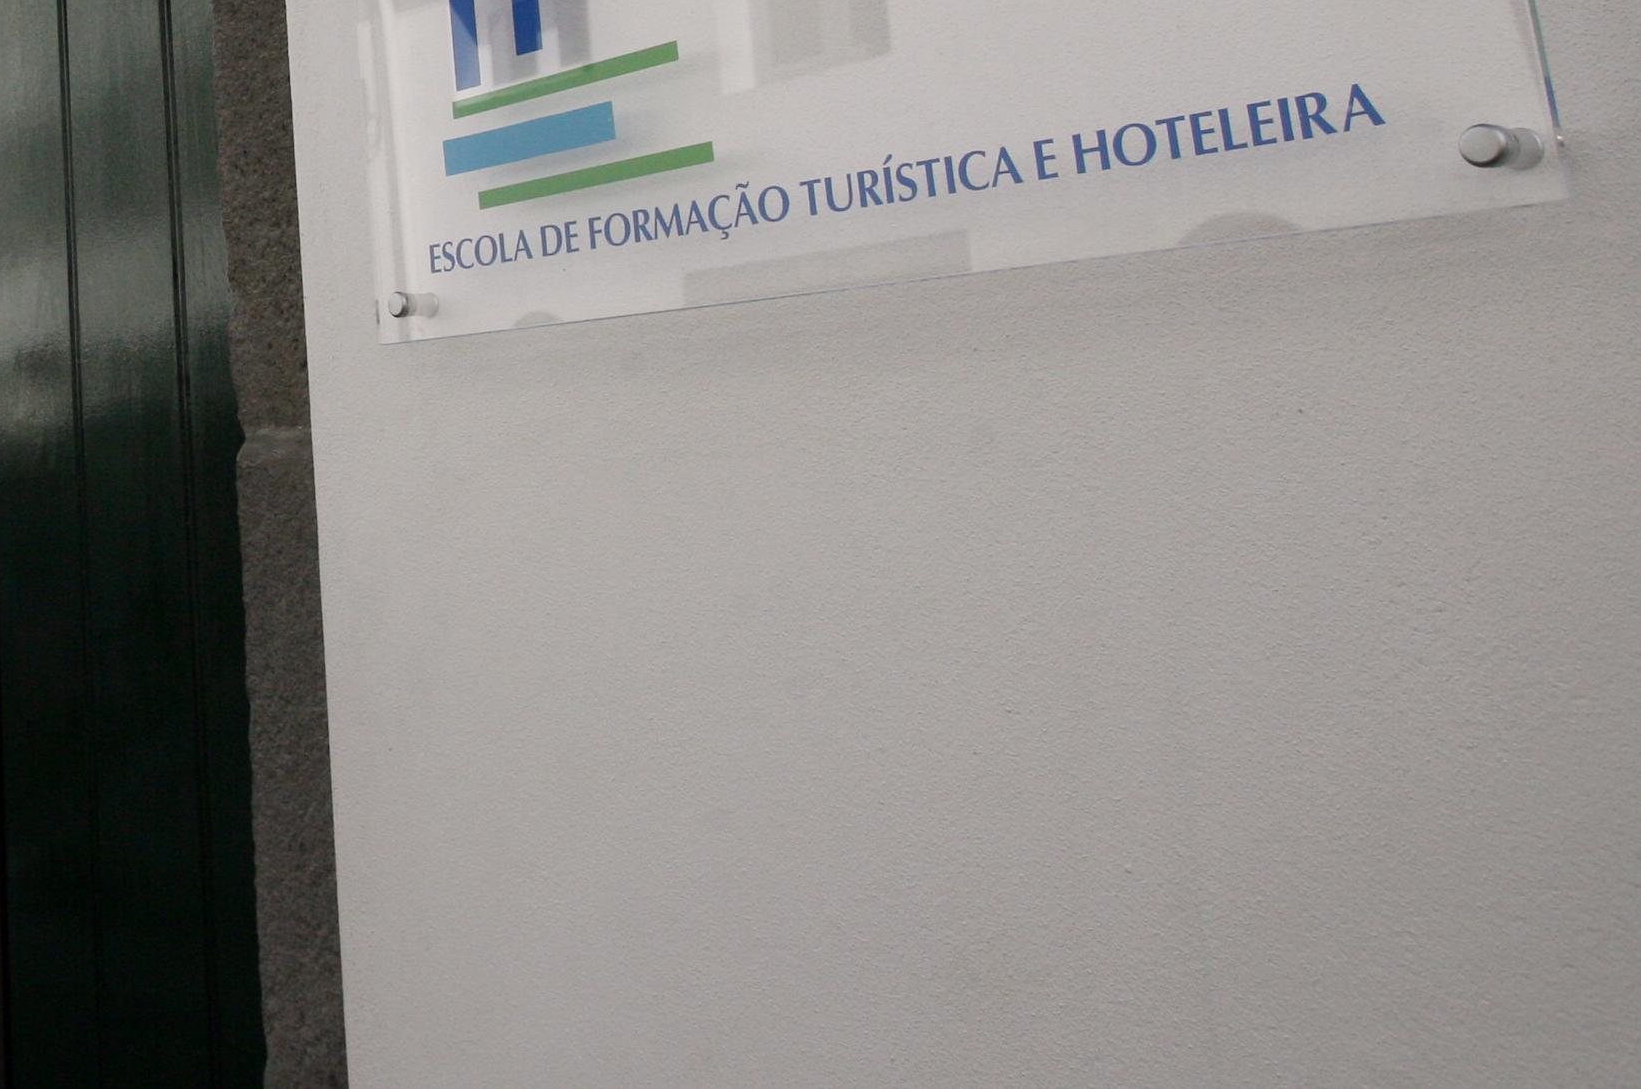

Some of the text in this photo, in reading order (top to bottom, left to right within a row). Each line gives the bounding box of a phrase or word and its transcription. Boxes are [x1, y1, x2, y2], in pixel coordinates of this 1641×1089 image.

[428, 82, 1387, 274] ESCOLA DE FORMAÇÃO TURÍSTICA E HOTELEIRA
